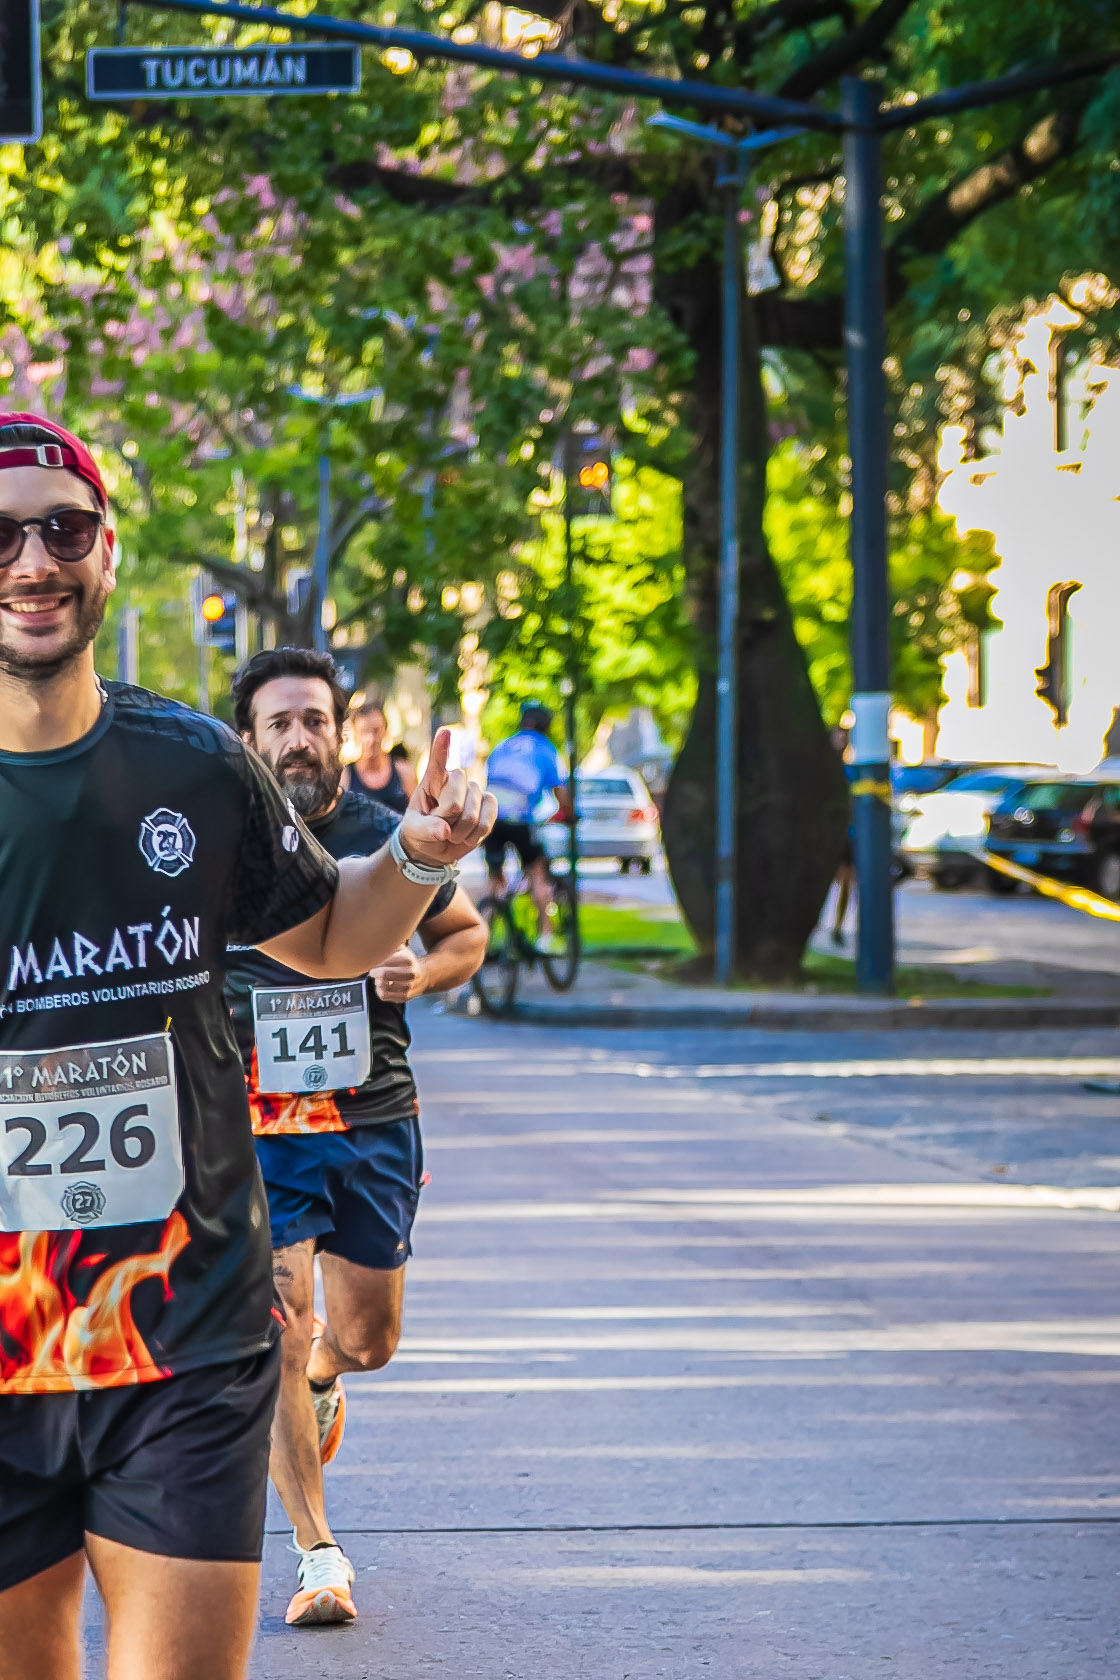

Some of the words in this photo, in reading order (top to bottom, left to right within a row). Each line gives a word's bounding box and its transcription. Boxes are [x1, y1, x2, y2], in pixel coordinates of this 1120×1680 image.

[141, 49, 306, 88] TUCUMÁN
[8, 904, 200, 991] MARATÓN
[16, 991, 90, 1013] BOMBEROS
[91, 980, 175, 1003] VOLUNTARIOS
[286, 989, 352, 1011] MARATÓN
[271, 1022, 356, 1063] 141
[32, 1048, 148, 1088] MARATÓN
[5, 1103, 156, 1176] 226
[74, 1195, 93, 1209] 27
